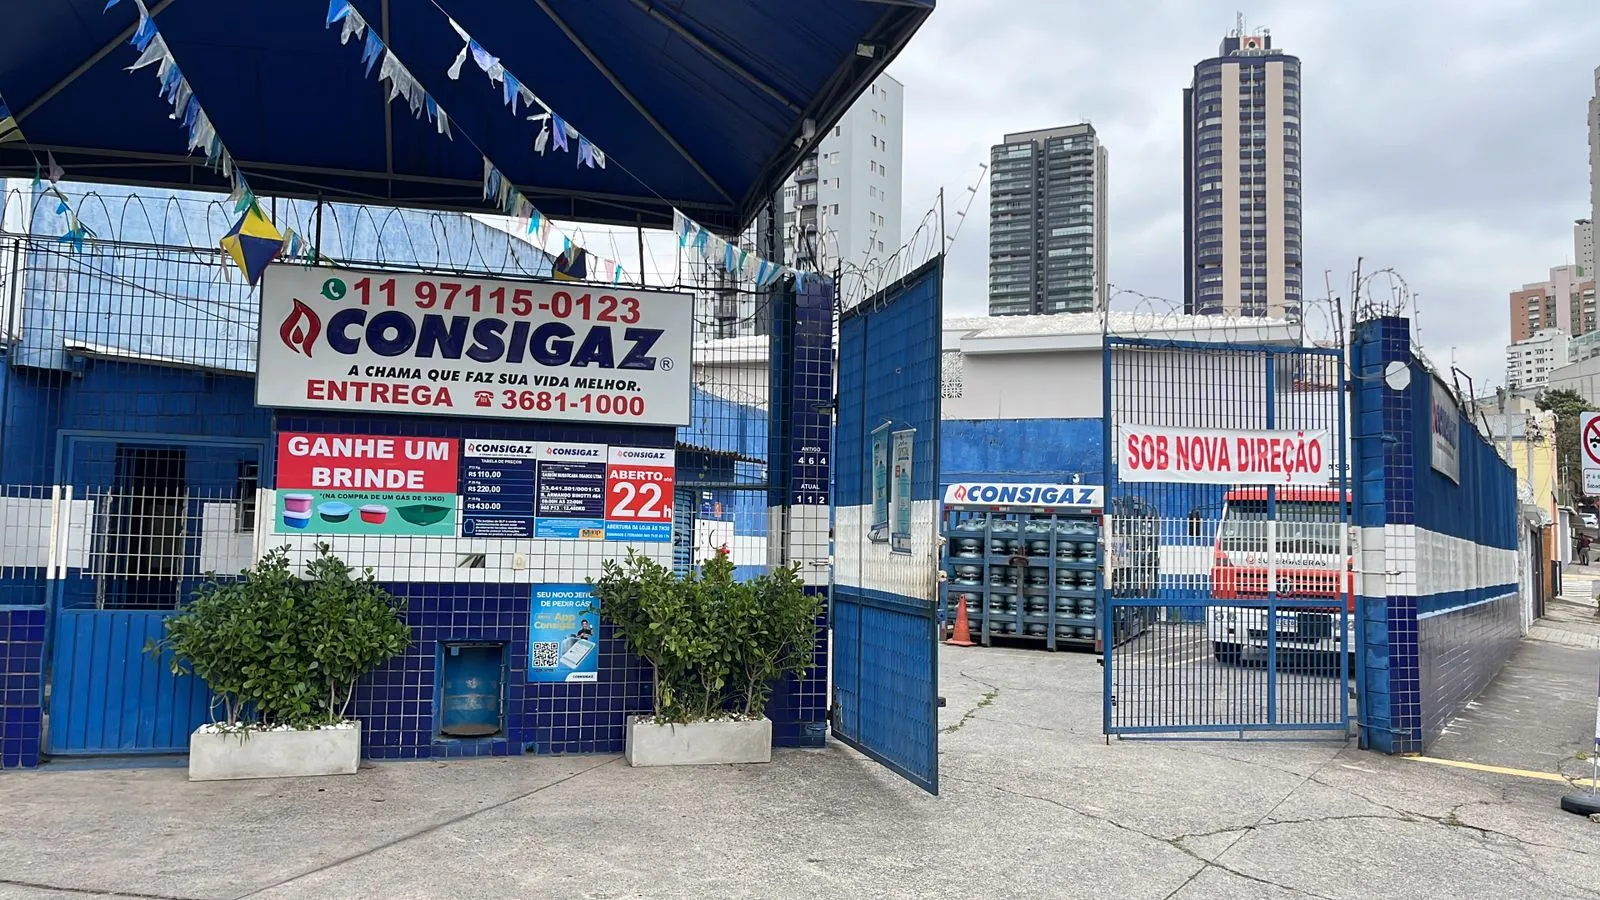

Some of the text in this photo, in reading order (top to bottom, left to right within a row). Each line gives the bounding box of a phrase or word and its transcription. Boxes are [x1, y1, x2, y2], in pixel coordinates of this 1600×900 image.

[353, 278, 641, 324] 11 97115-0123
[326, 308, 665, 371] CONSIGAZ
[347, 365, 641, 392] A CHAMA QUE FAZ SUA VIDA MELHOR.
[307, 380, 645, 416] ENTREGA 3681-1000
[288, 436, 449, 461] GANHE UM
[476, 444, 532, 454] CONSIGAZ
[553, 448, 599, 456] CONSIGAZ
[1128, 432, 1322, 482] SOB NOVA DIREÇÃO
[312, 467, 424, 489] BRINDE
[610, 470, 663, 480] ABERTO
[611, 481, 671, 518] 22 h
[967, 485, 1096, 504] CONSIGAZ
